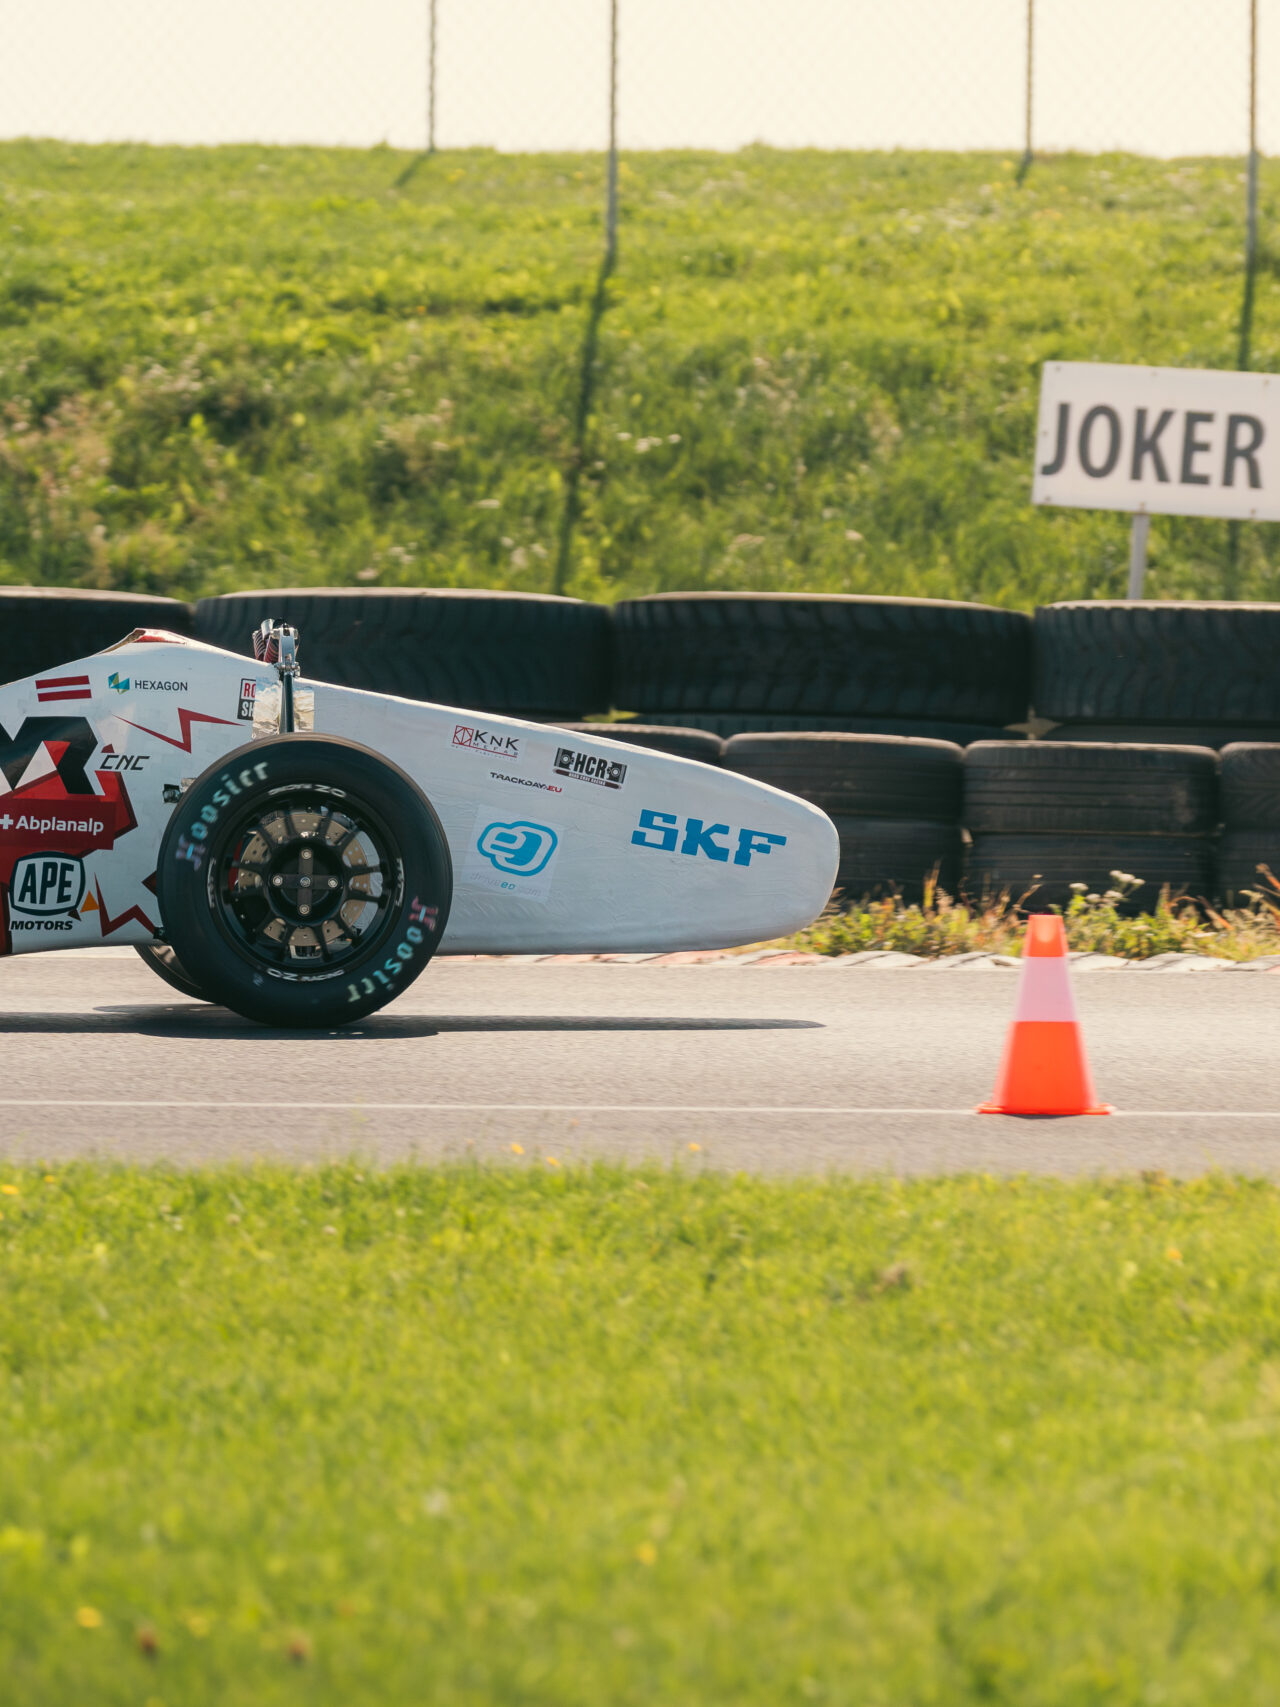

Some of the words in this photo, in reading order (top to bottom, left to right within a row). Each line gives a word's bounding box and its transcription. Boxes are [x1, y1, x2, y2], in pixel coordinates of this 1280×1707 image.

[1040, 402, 1265, 490] JOKER
[134, 679, 188, 692] HEXAGON
[99, 755, 151, 771] CNC
[573, 752, 608, 779] HCR
[15, 816, 105, 836] Abplanalp
[631, 808, 787, 867] SKF
[18, 861, 75, 905] APE
[10, 920, 73, 931] MOTORS
